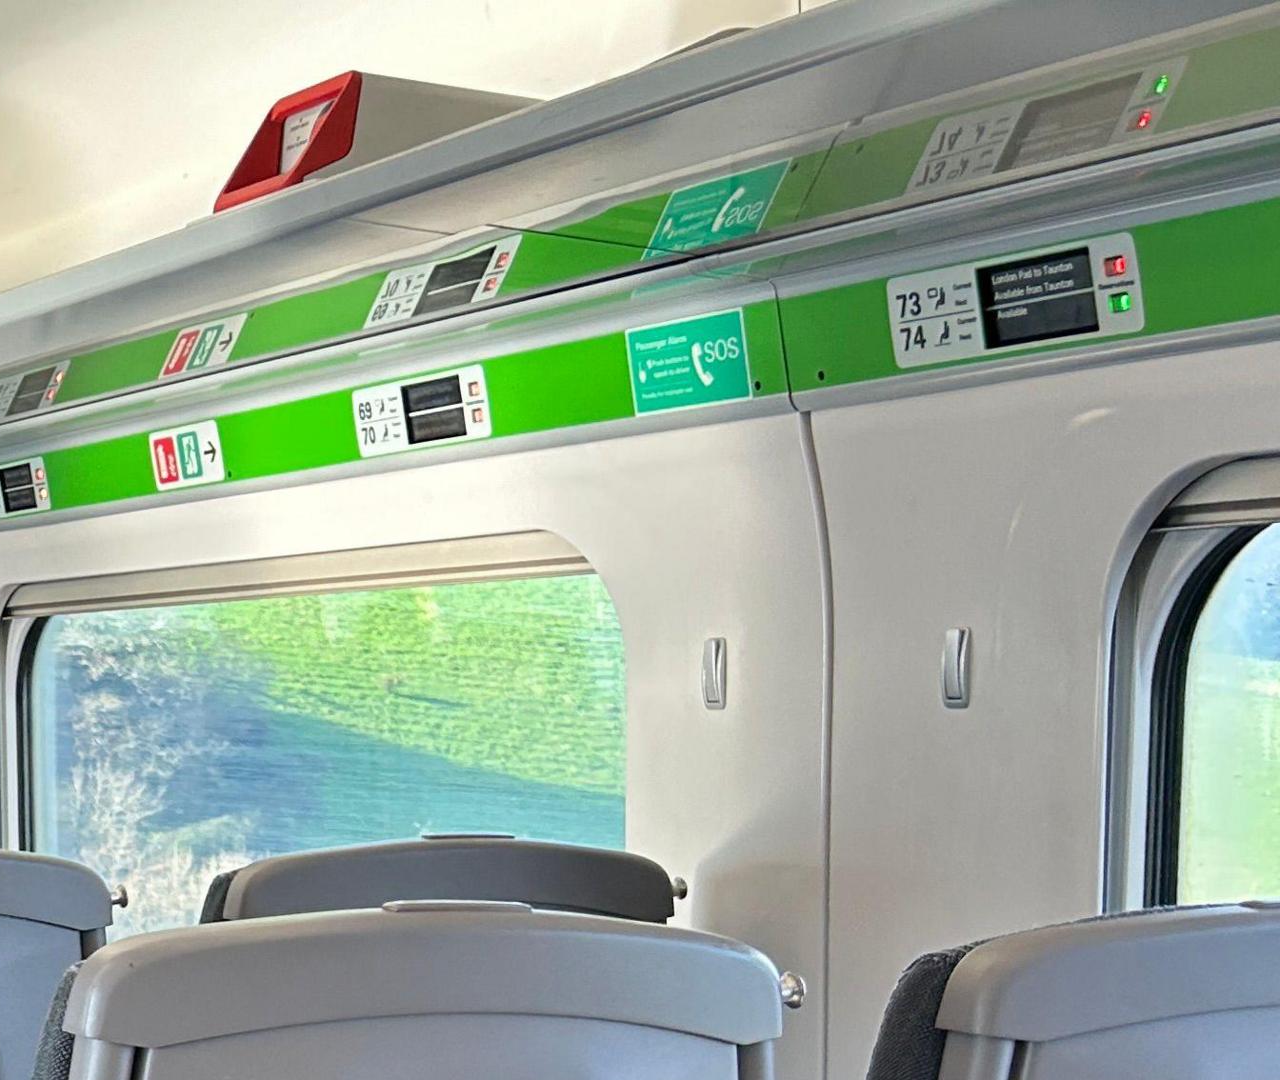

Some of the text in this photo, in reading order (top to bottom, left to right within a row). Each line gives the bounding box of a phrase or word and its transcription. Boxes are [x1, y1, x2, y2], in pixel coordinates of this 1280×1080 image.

[992, 273, 1018, 286] London
[1042, 263, 1074, 275] Taunton
[994, 288, 1025, 302] Available
[1043, 280, 1075, 292] Taunton
[896, 292, 922, 318] 73
[900, 325, 926, 351] 74
[704, 337, 740, 363] SOS
[358, 402, 372, 421] 69
[362, 427, 376, 445] 70
